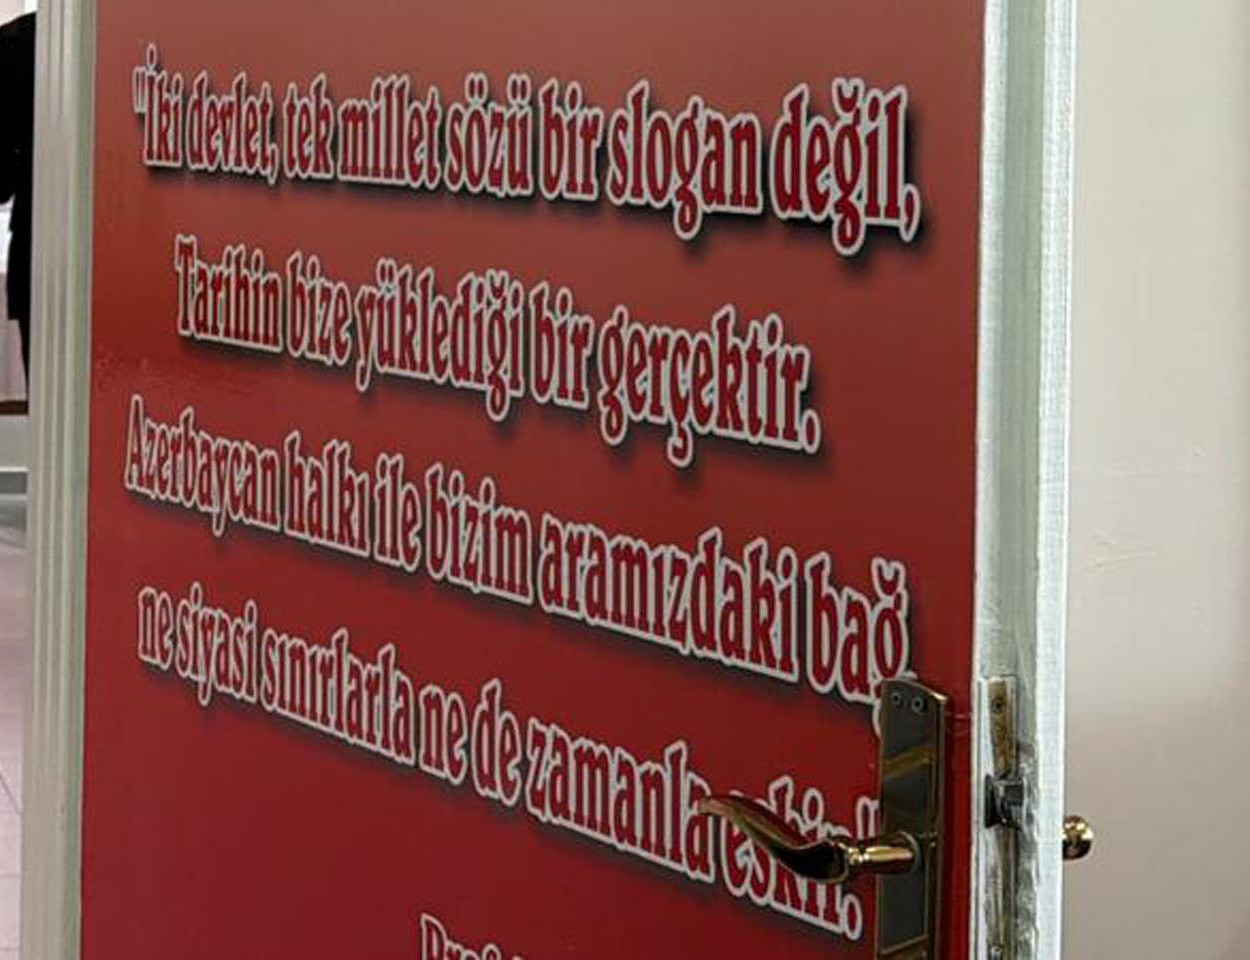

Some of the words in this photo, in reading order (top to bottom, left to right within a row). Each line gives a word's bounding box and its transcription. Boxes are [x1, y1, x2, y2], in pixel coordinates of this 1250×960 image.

[186, 70, 279, 185] devlet,
[283, 72, 335, 179] tek
[337, 74, 441, 189] millet
[444, 72, 534, 197] sözü
[539, 77, 603, 201] bir
[606, 79, 764, 240] slogan
[769, 77, 921, 257] değil,
[174, 233, 284, 354] Tarihin
[286, 250, 352, 367] bize
[354, 257, 525, 422] yüklediği
[529, 280, 595, 410] bir
[598, 303, 822, 468] gerçektir.
[124, 393, 281, 537] Azerbaycan
[284, 429, 372, 558] halkı
[373, 452, 422, 573] ile
[425, 461, 534, 605] bizim
[538, 510, 800, 683] aramızdaki
[804, 551, 912, 736] bağ
[138, 585, 174, 672] ne
[175, 581, 257, 707] siyasi
[259, 626, 416, 768] sınırlarla
[418, 683, 469, 786] ne
[471, 676, 522, 807] de
[525, 717, 716, 884] zamanla
